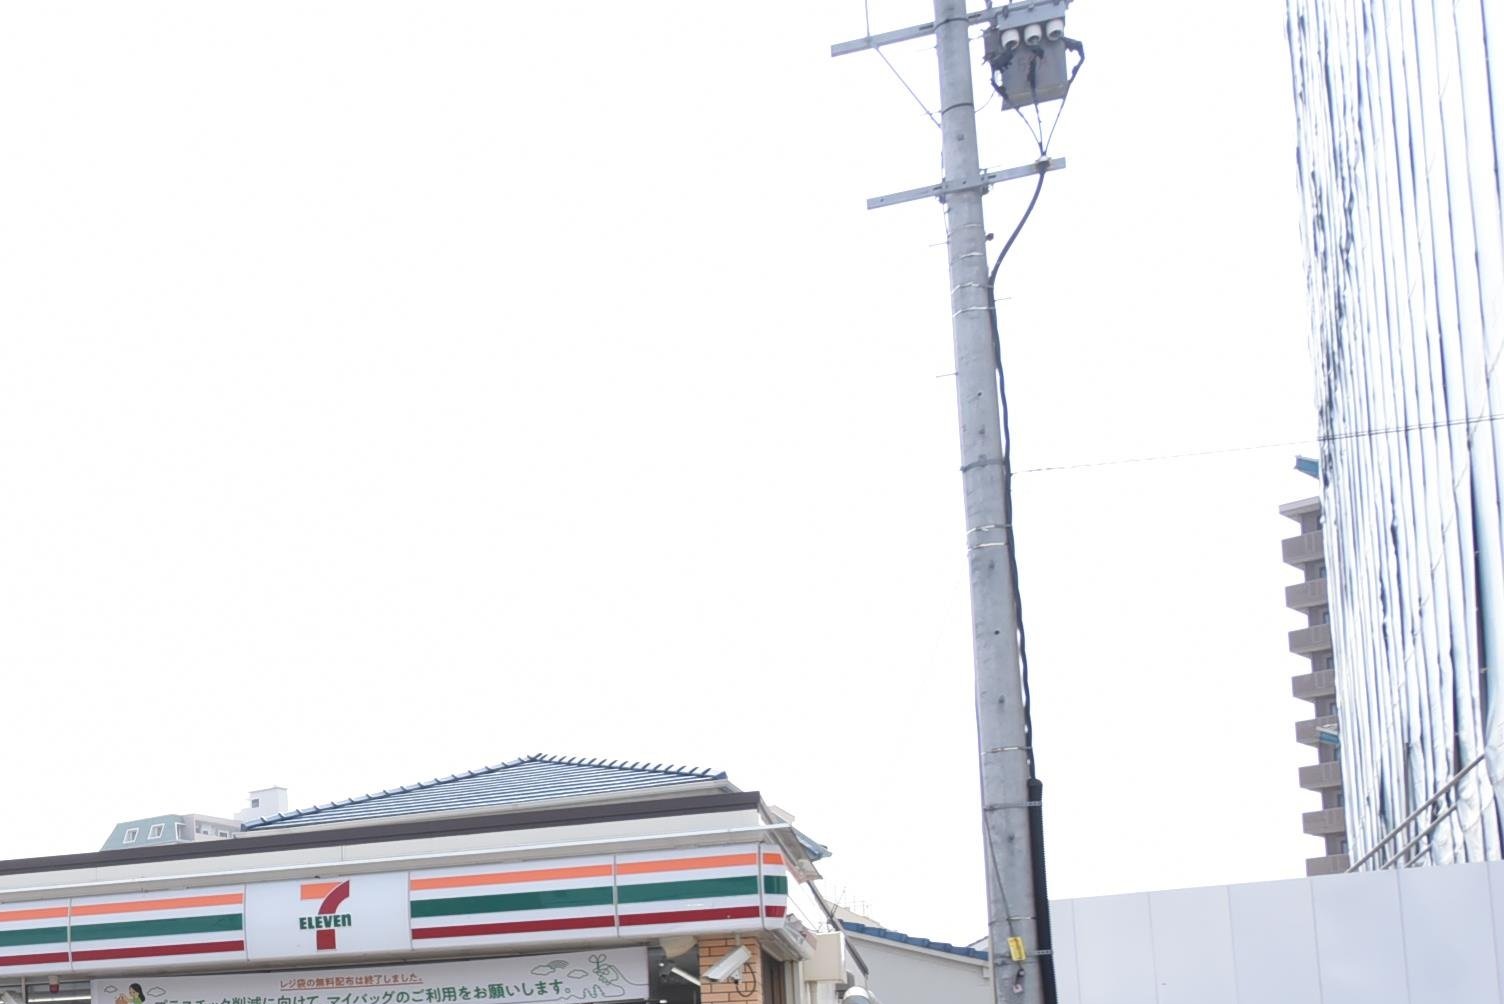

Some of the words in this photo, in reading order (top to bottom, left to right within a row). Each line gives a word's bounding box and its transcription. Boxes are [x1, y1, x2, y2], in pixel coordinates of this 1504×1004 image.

[300, 880, 350, 950] 7
[280, 972, 424, 988] レジ袋の無料配布は終了しました。
